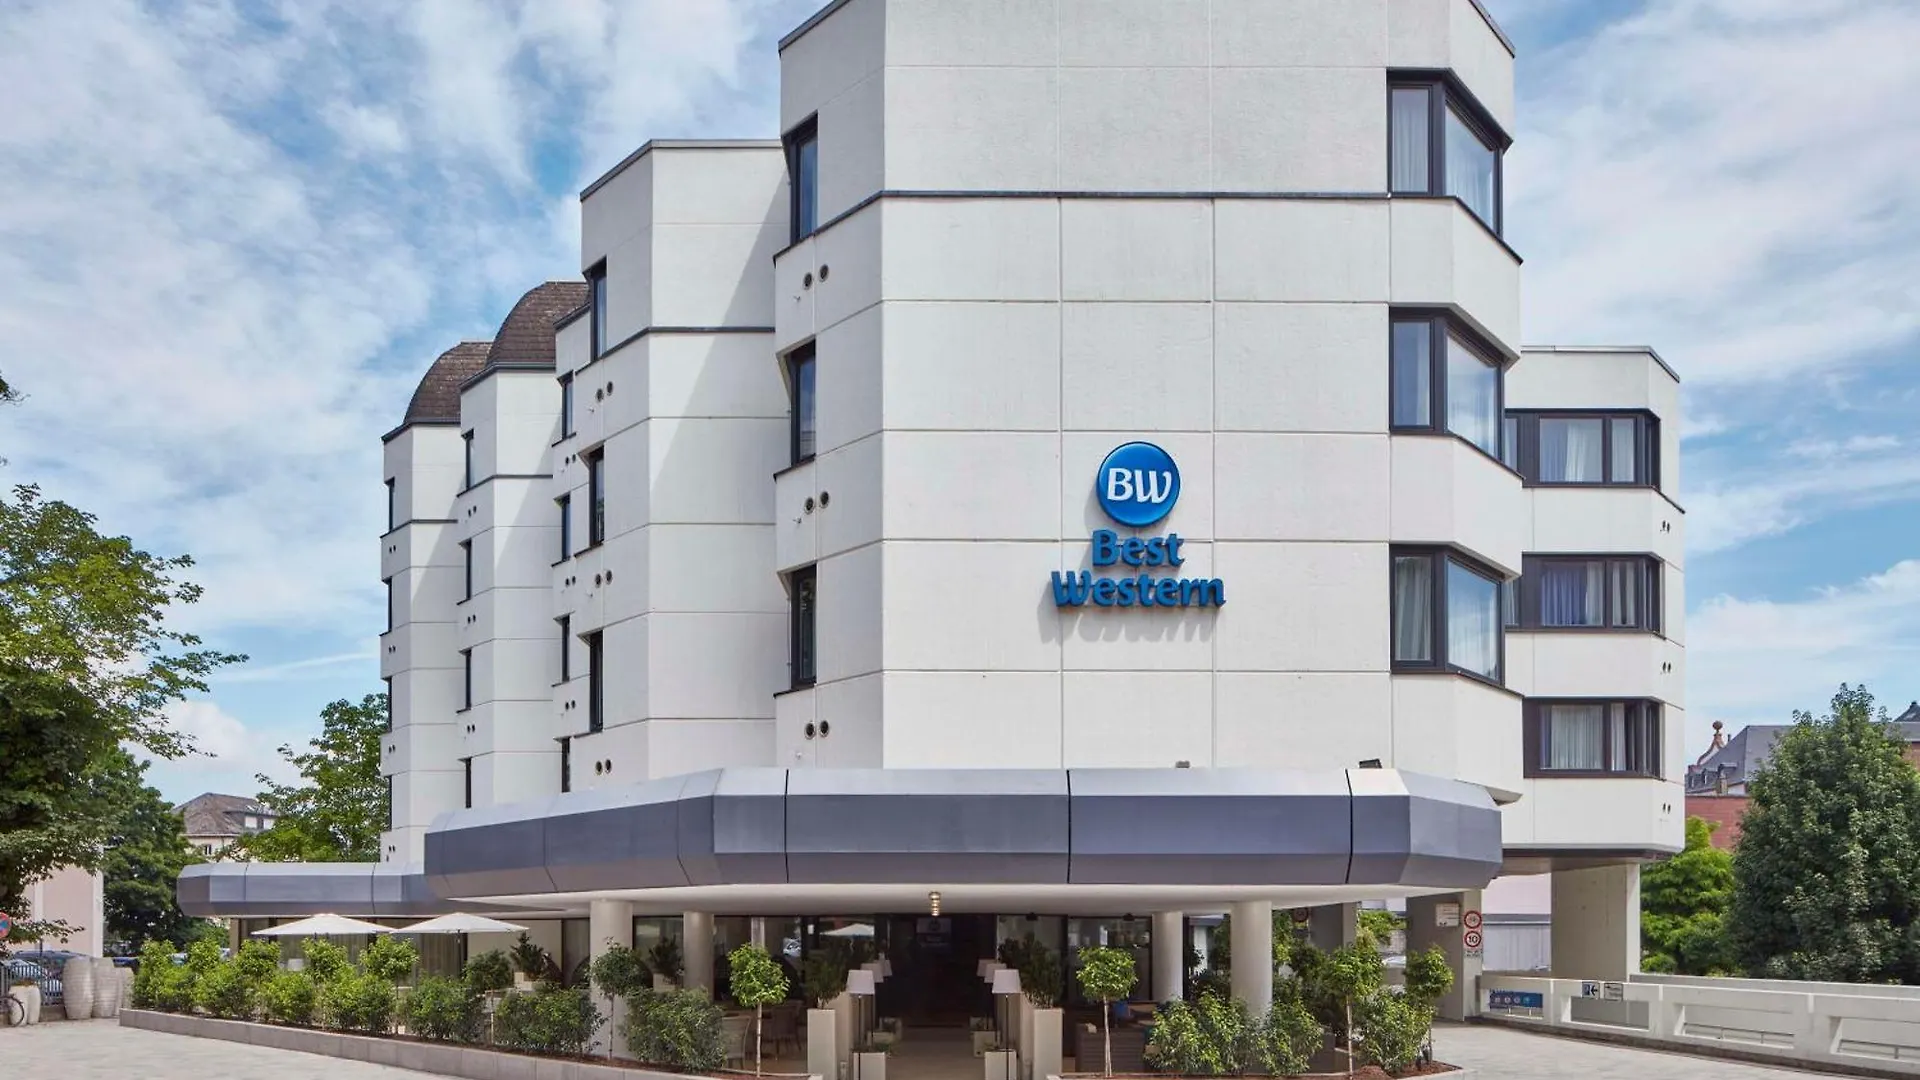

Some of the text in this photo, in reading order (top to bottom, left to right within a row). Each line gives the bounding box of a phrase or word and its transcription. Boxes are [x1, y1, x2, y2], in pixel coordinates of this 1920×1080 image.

[1107, 467, 1172, 504] BW
[1092, 529, 1185, 567] Best
[1051, 570, 1226, 607] Western
[1468, 935, 1478, 944] 10
